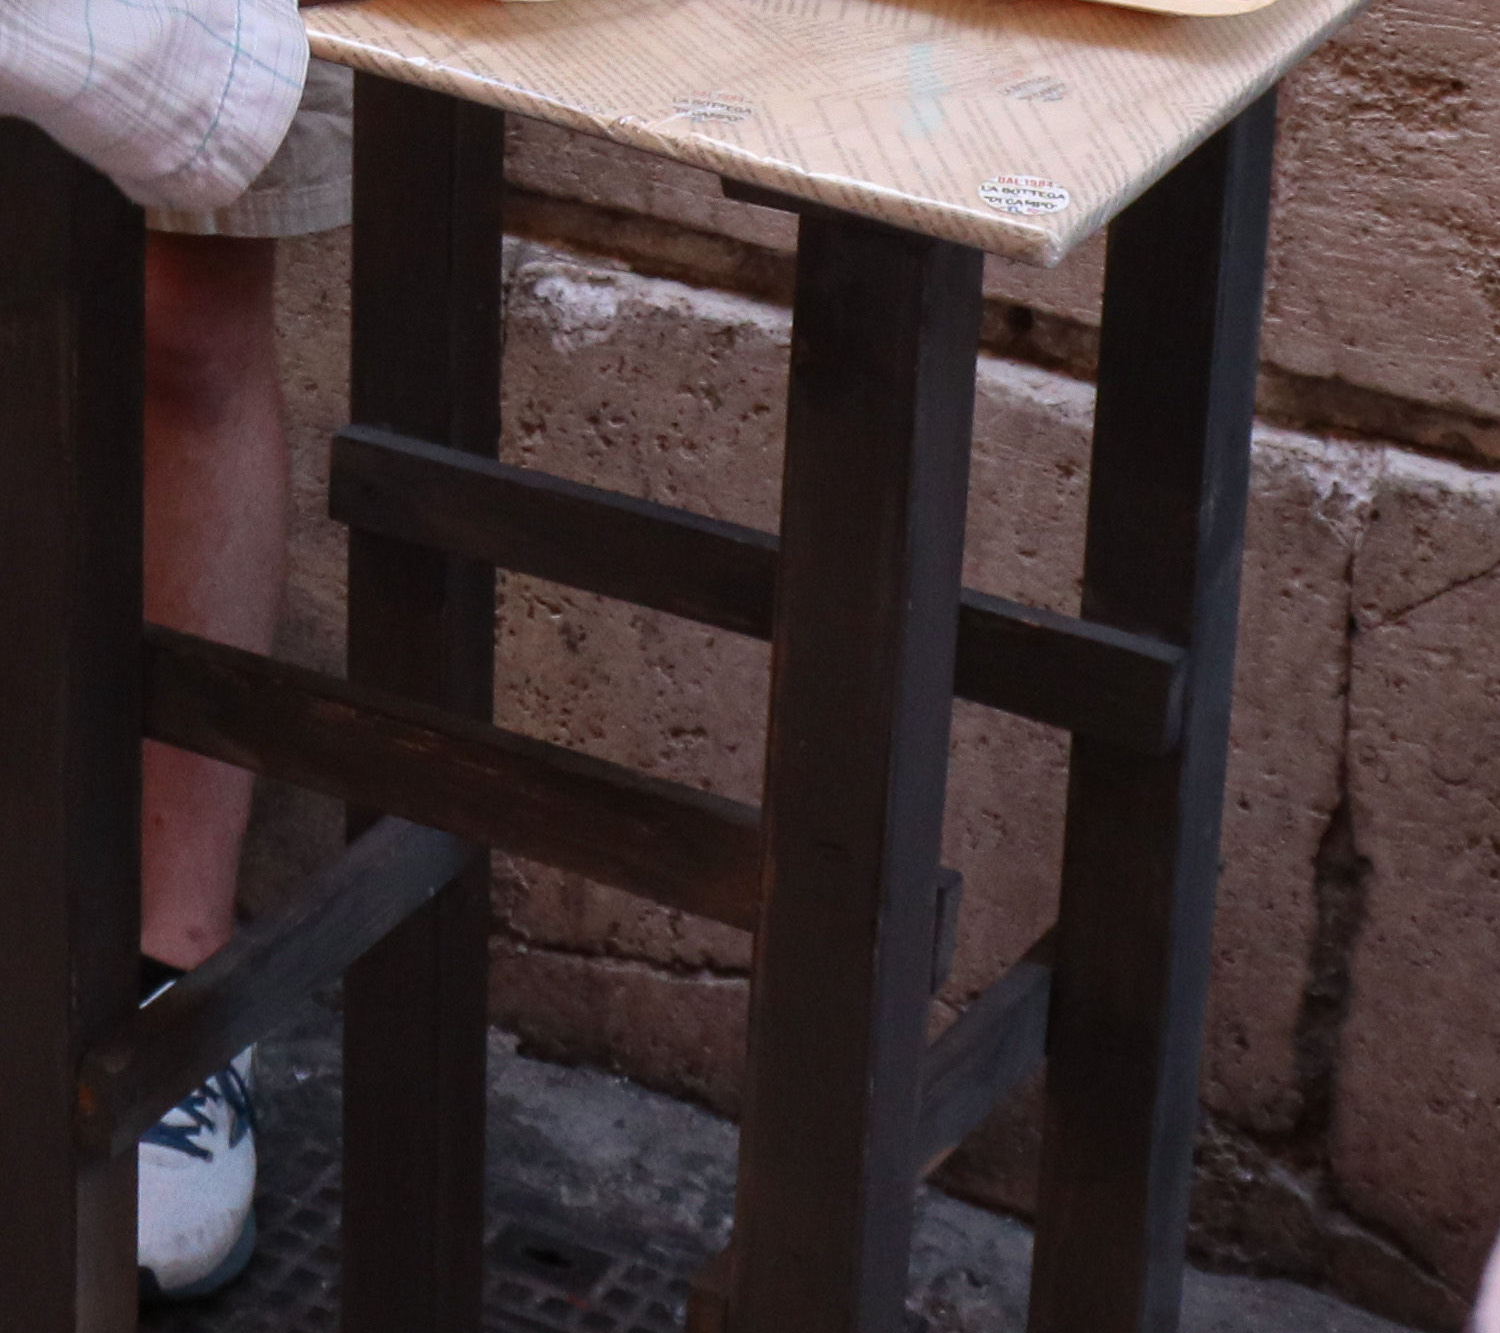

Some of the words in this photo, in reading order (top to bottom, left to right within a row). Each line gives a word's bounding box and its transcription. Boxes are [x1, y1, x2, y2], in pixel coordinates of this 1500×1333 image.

[998, 176, 1019, 186] DAL
[1025, 178, 1054, 188] 1984
[981, 185, 998, 193] LA
[1001, 187, 1065, 200] BOTTEGA
